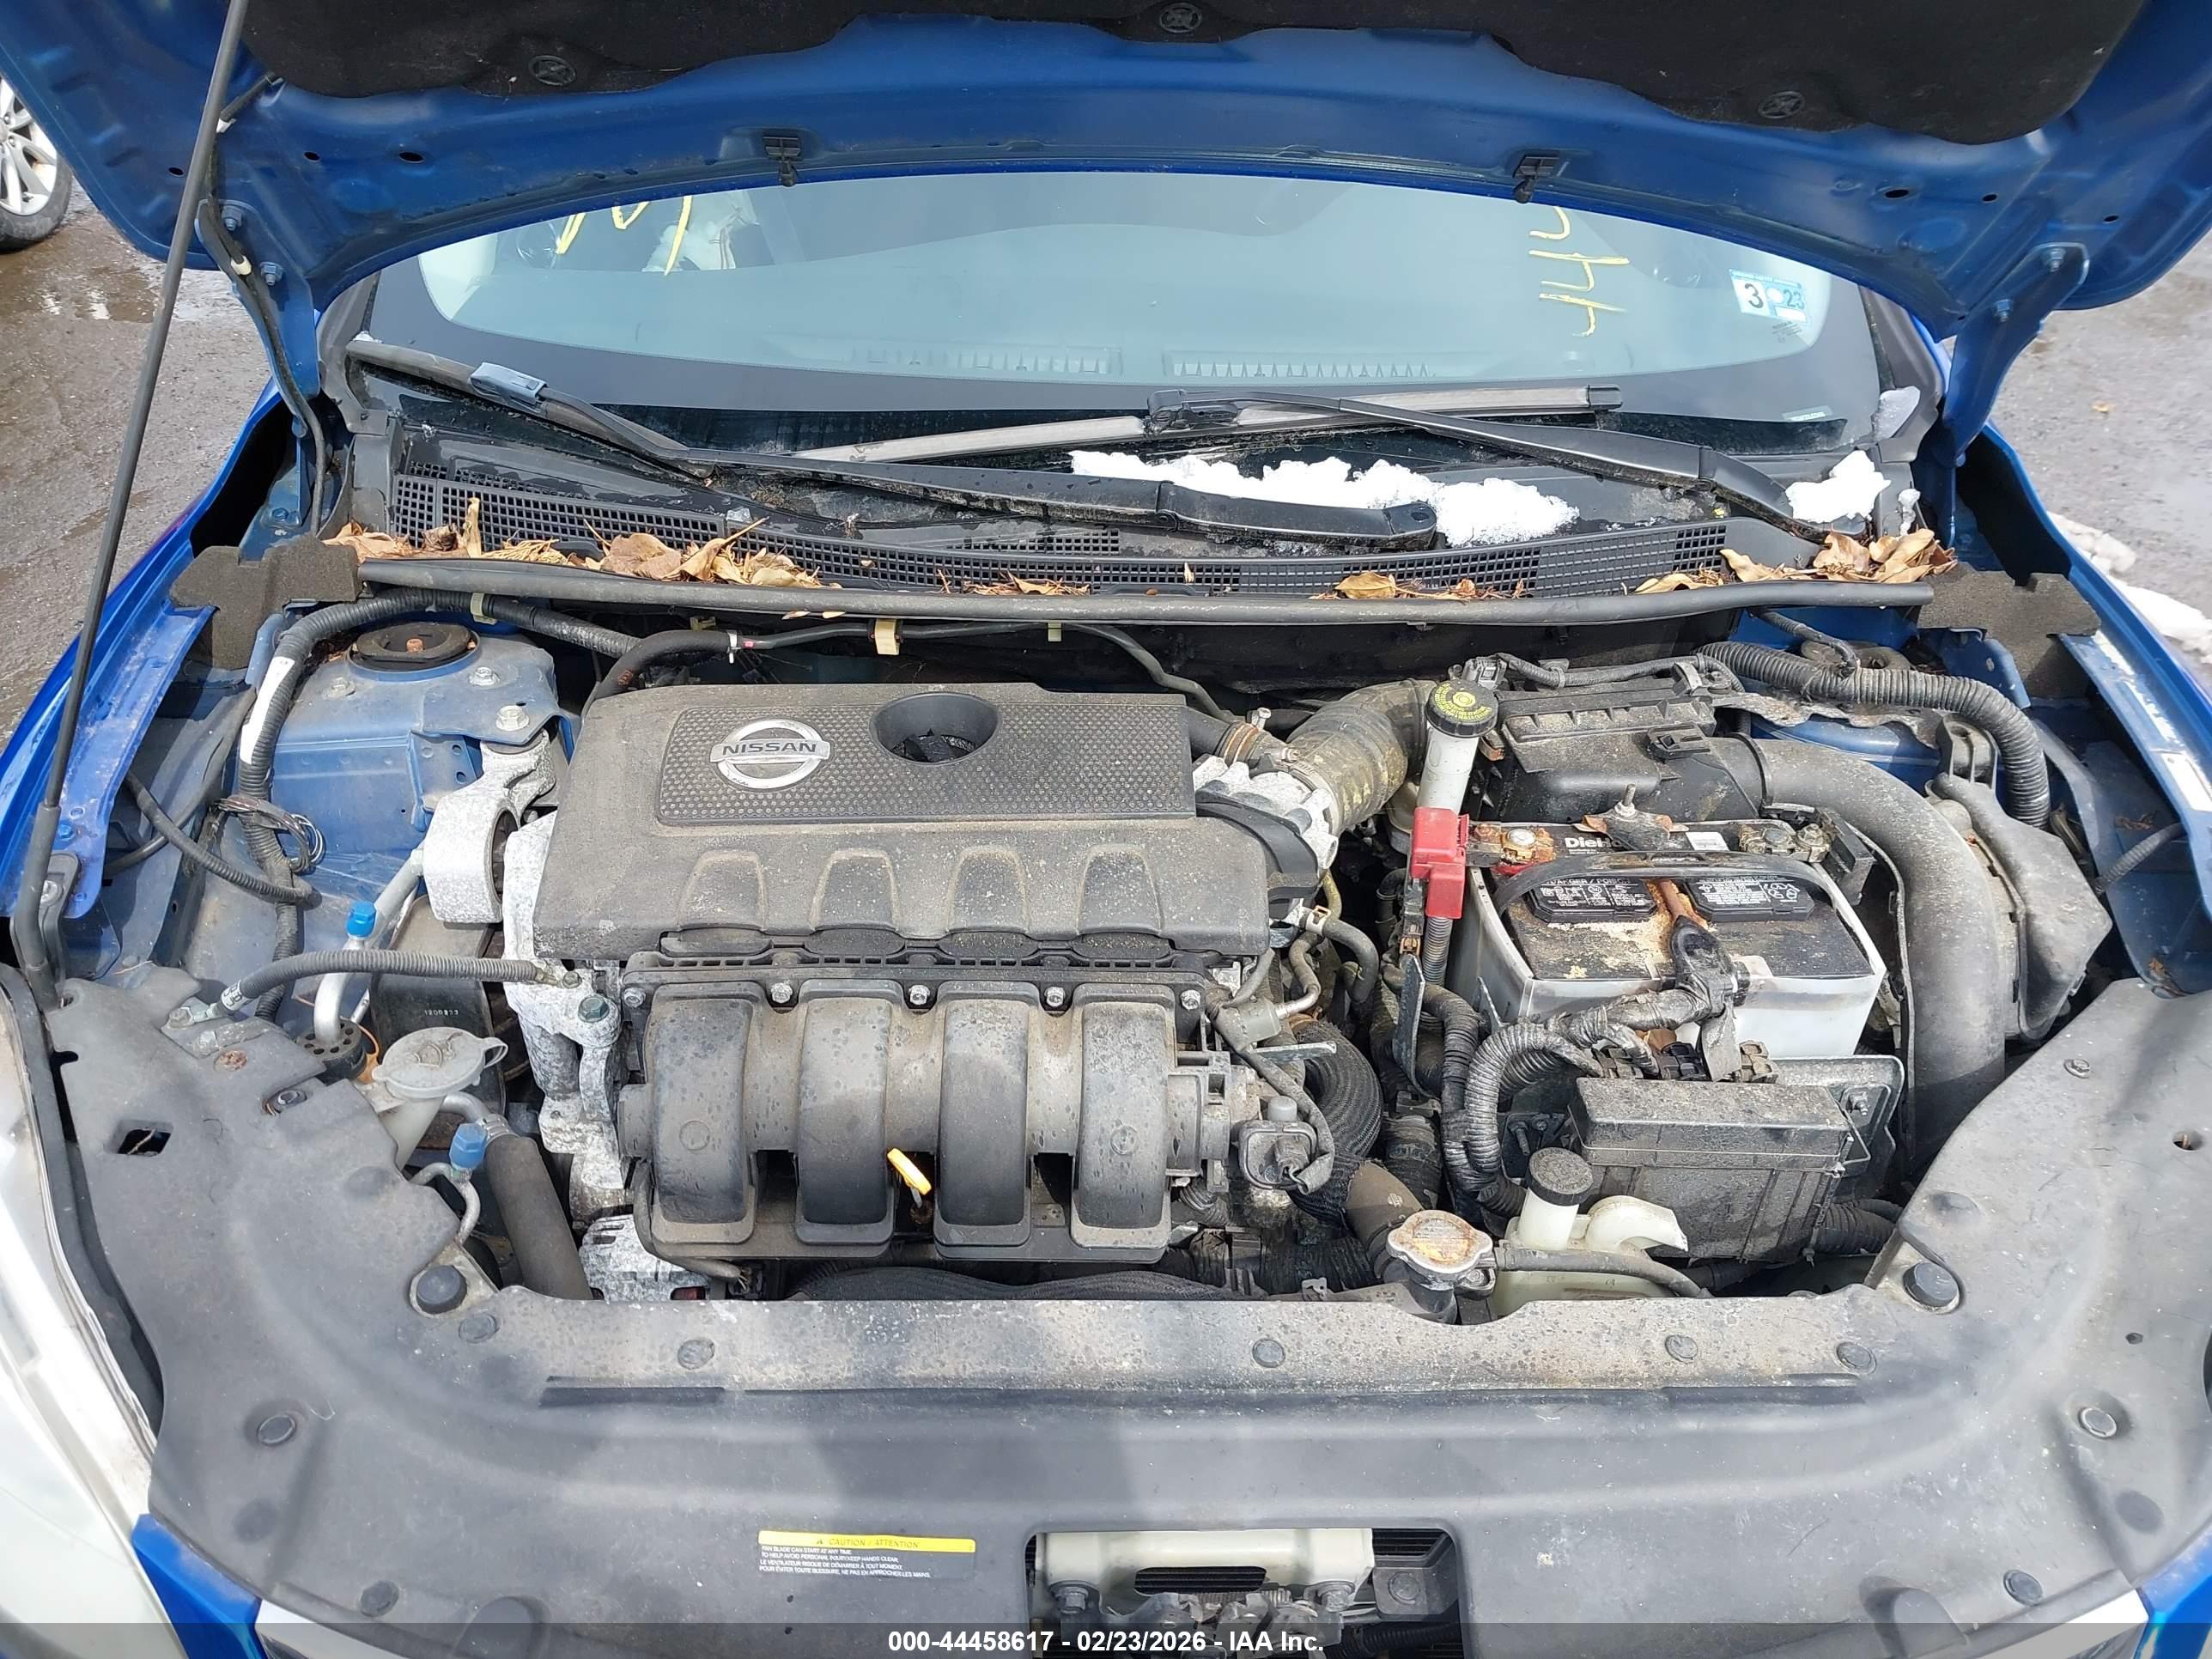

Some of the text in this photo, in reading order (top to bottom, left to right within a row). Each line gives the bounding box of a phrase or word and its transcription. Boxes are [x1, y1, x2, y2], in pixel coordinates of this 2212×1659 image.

[1744, 283, 1764, 309] 3
[722, 742, 817, 756] NISSAN
[829, 1538, 866, 1547] CAUTION
[874, 1539, 919, 1548] ATTENTION
